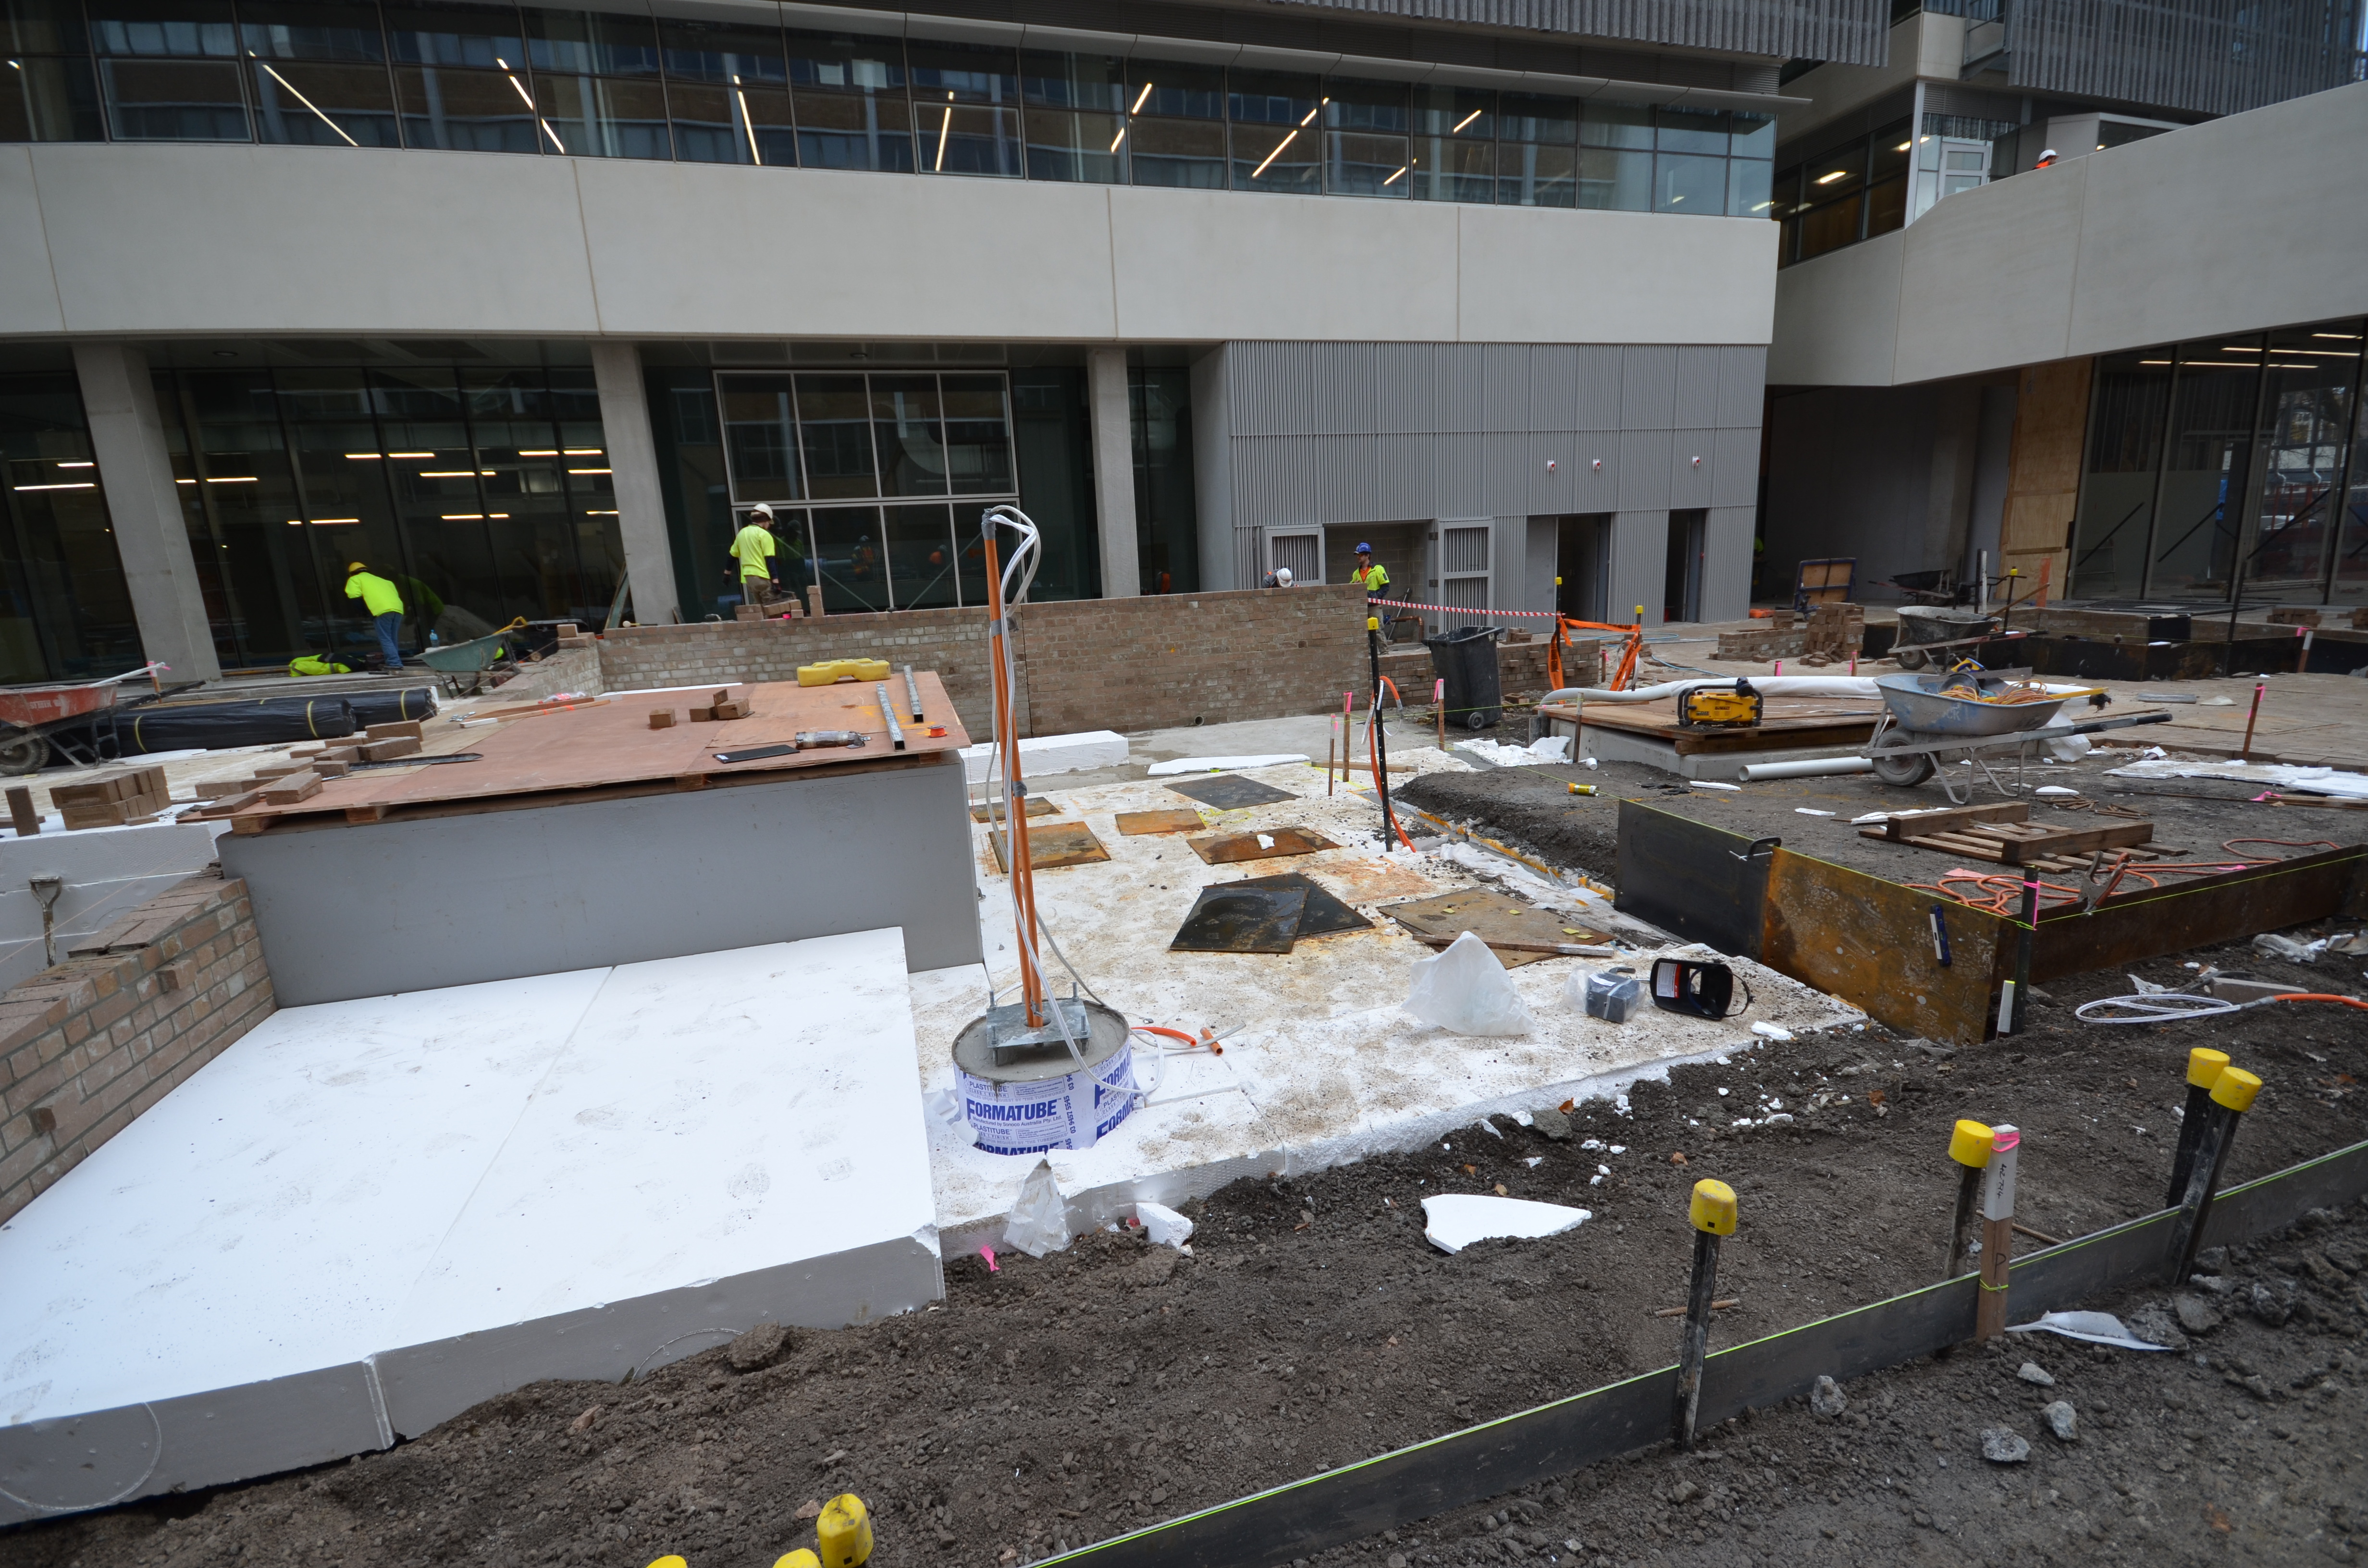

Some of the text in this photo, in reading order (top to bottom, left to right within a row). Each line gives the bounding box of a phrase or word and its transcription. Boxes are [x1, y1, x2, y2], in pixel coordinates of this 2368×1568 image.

[967, 1097, 1057, 1121] FORMATUBE
[973, 1116, 996, 1126] Manufactured
[1994, 1252, 2007, 1280] P
